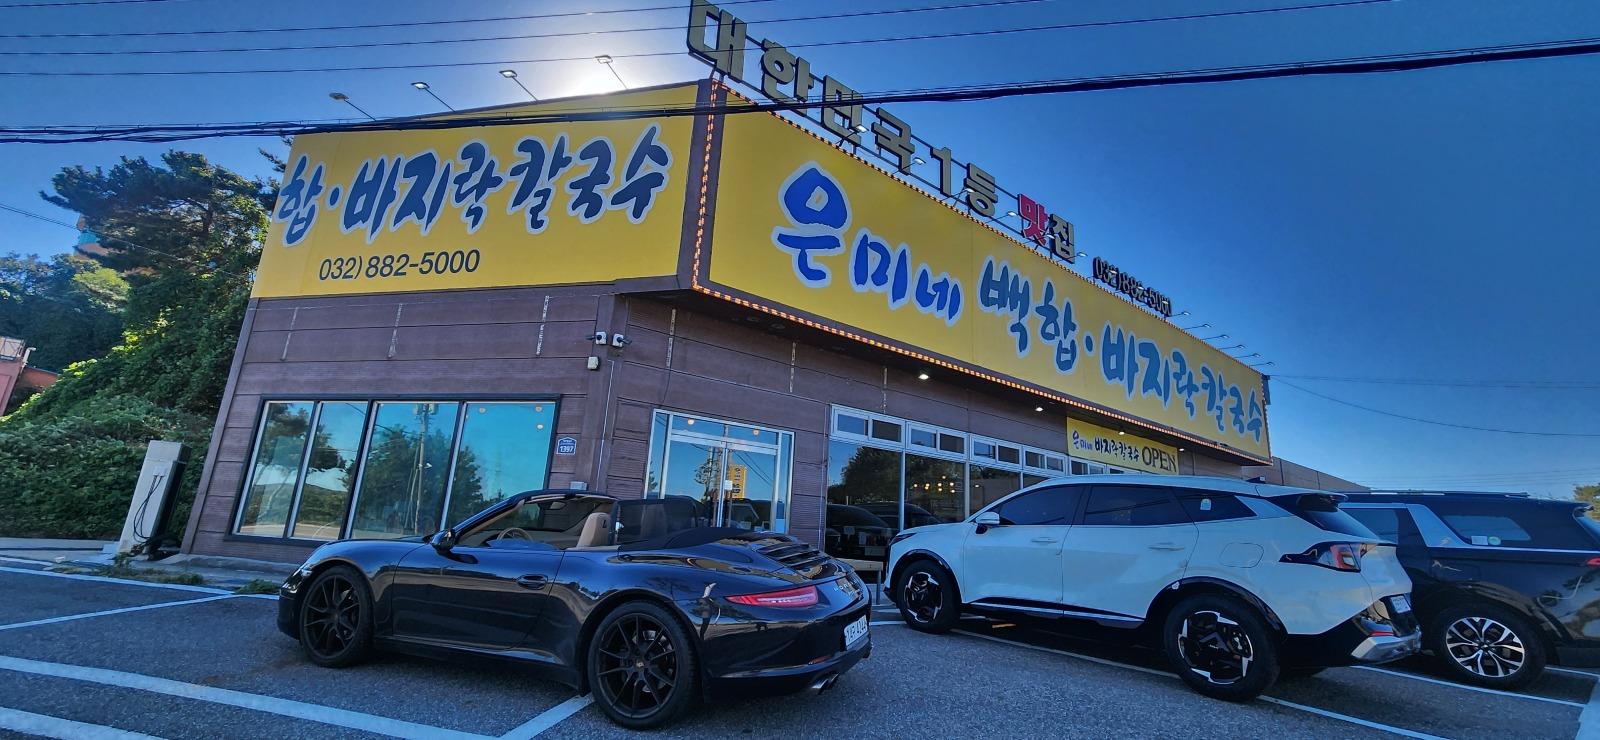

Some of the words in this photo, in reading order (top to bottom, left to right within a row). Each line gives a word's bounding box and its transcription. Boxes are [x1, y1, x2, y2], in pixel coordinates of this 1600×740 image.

[686, 0, 916, 175] 대한민국
[930, 147, 999, 217] 1등
[1017, 194, 1075, 264] 맛집
[776, 166, 962, 321] 은미네
[1141, 446, 1177, 473] OPEN
